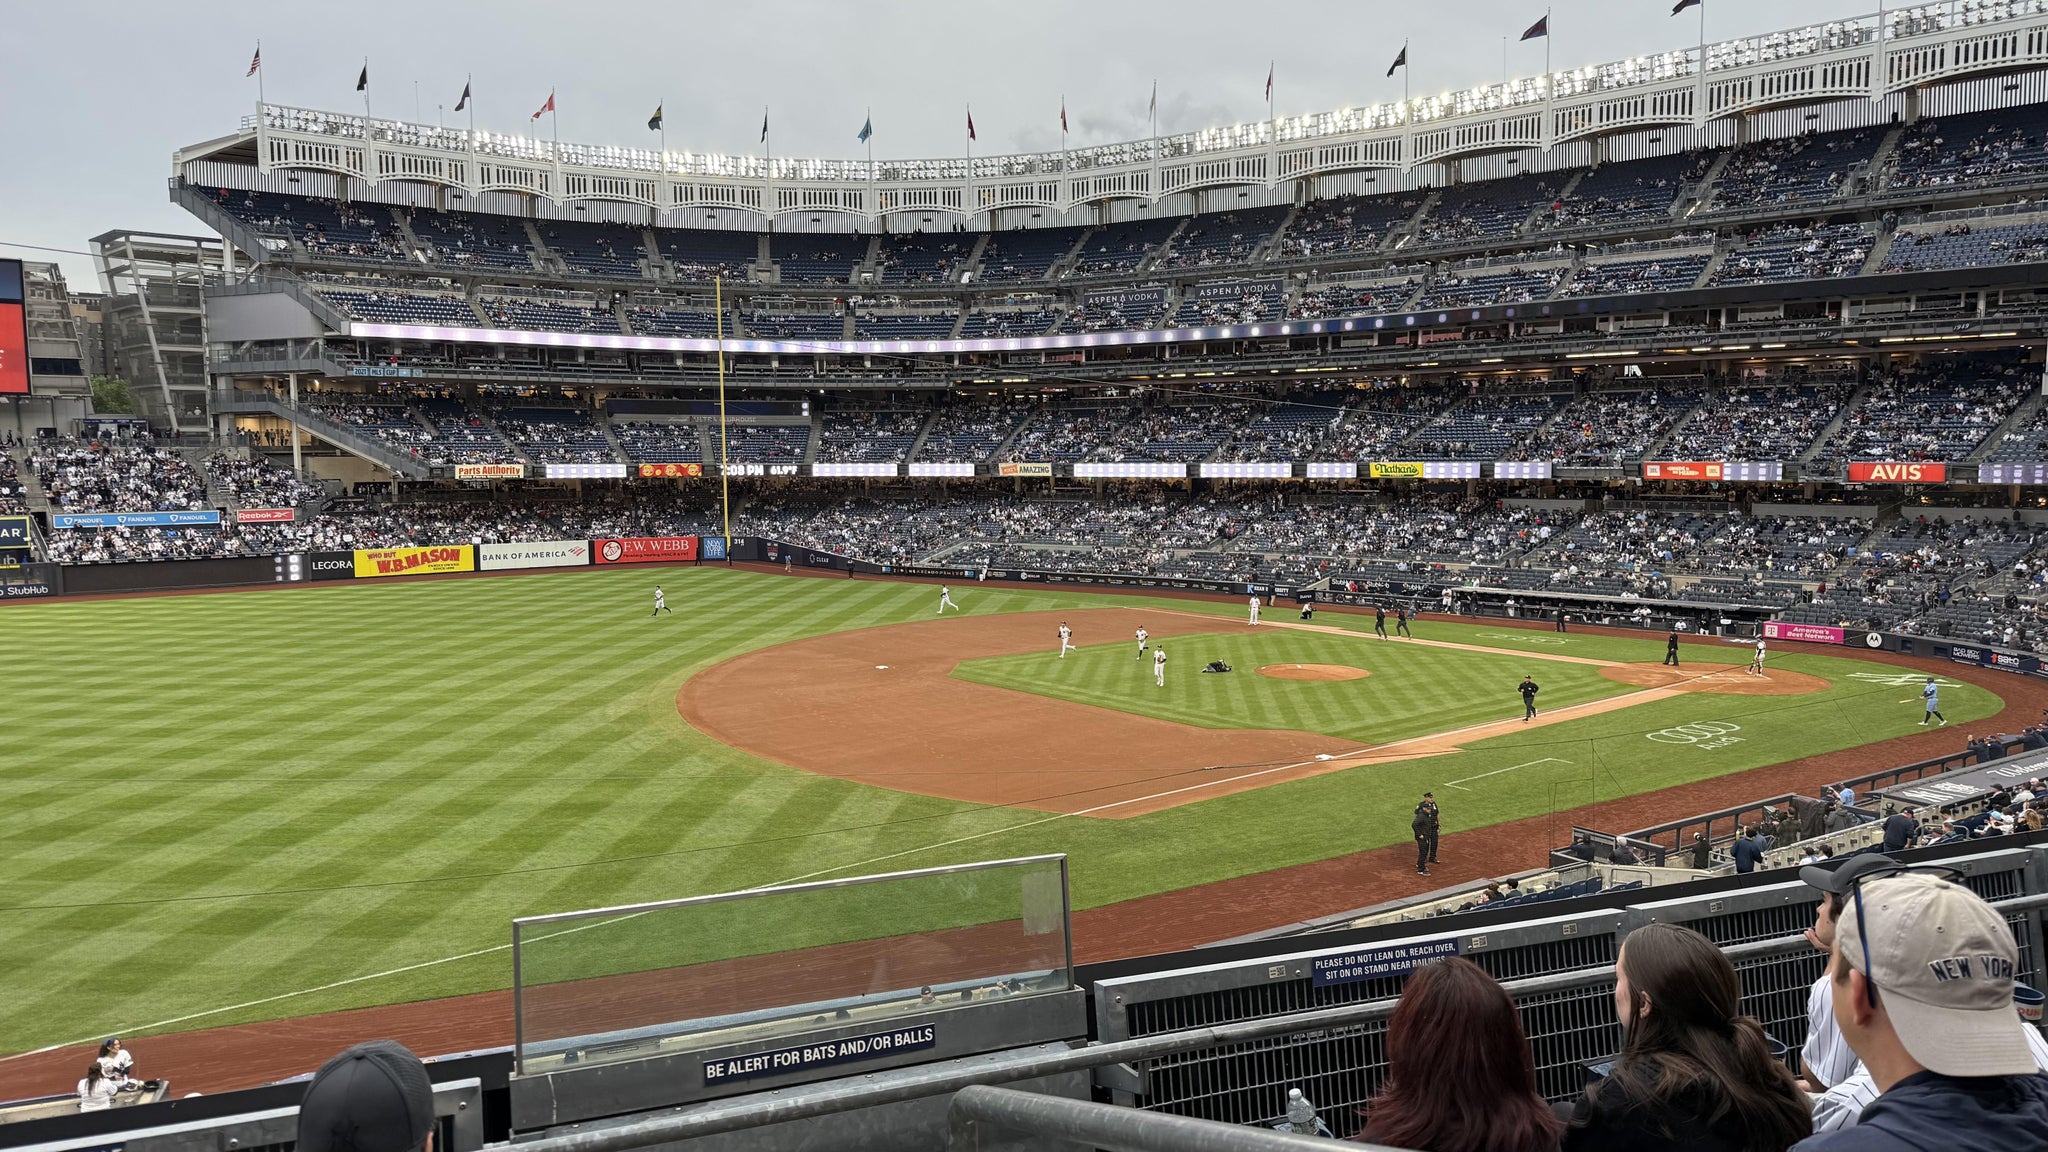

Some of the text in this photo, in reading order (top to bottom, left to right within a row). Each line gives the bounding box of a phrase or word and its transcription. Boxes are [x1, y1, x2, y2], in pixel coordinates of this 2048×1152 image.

[1200, 284, 1277, 296] ASPEN VODKA
[1089, 293, 1159, 304] ASPEN VODKA
[354, 367, 367, 375] 2021
[385, 368, 396, 376] CUP
[458, 465, 520, 475] Parts Authority
[746, 465, 764, 476] PM
[1020, 466, 1050, 474] AMAZING
[1374, 463, 1420, 475] Nathan's
[1870, 464, 1922, 481] AVIS
[239, 512, 272, 520] Reebok
[624, 539, 689, 552] F.W. WEBB
[482, 551, 567, 561] BANK OF AMERICA
[312, 560, 353, 570] LEGORA
[8, 585, 49, 595] StubHub
[1793, 627, 1830, 635] America's
[1804, 633, 1835, 641] Network
[1953, 652, 1980, 660] MOWERS
[1997, 655, 2020, 665] sato
[1315, 943, 1456, 970] PLEASE DO NOT LEAN ON, REACH OVER,
[1325, 970, 1338, 980] SIT
[1339, 969, 1350, 978] ON
[1352, 967, 1363, 976] OR
[1364, 963, 1389, 975] STAND
[1390, 959, 1411, 971] NEAR
[1928, 956, 1972, 983] NEW
[707, 1028, 933, 1079] BE ALERT FOR BATS AND/OR BALLS
